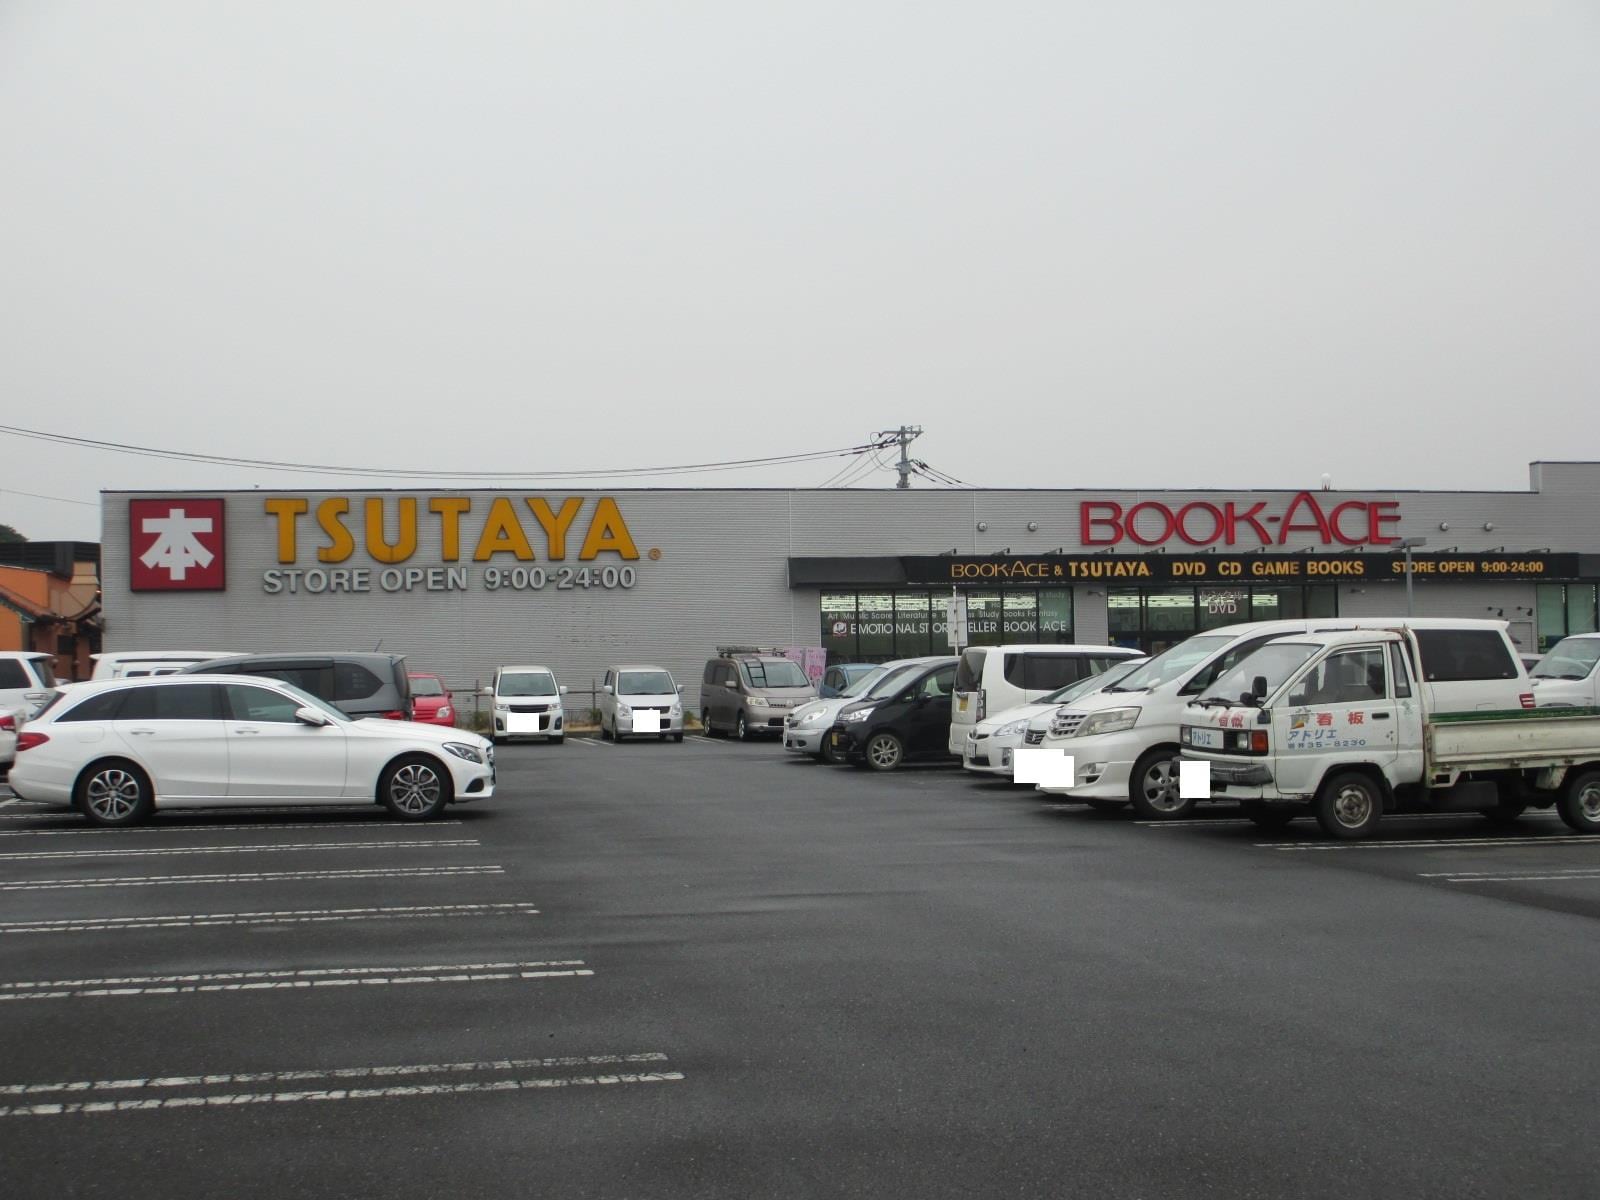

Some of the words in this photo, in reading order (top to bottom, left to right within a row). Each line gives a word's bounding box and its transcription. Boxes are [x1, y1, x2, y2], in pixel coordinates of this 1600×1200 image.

[264, 497, 640, 564] TSUTAYA
[1080, 491, 1402, 546] BOOK-ACE
[139, 508, 215, 581] 本
[263, 568, 370, 593] STORE
[380, 567, 468, 591] OPEN
[484, 566, 637, 590] 9:00-24:00
[951, 560, 1049, 577] BOOK-ACE
[1054, 564, 1063, 576] &
[1068, 561, 1150, 577] TSUTAYA
[1172, 562, 1206, 576] DVD
[1218, 562, 1242, 576] CD
[1251, 562, 1299, 576] GAME
[1307, 561, 1364, 575] BOOKS
[1391, 561, 1436, 573] STORE
[1438, 561, 1475, 573] OPEN
[1481, 561, 1544, 573] 9:00-24:00
[1208, 603, 1237, 614] DVD
[850, 623, 916, 635] EMOTIONAL
